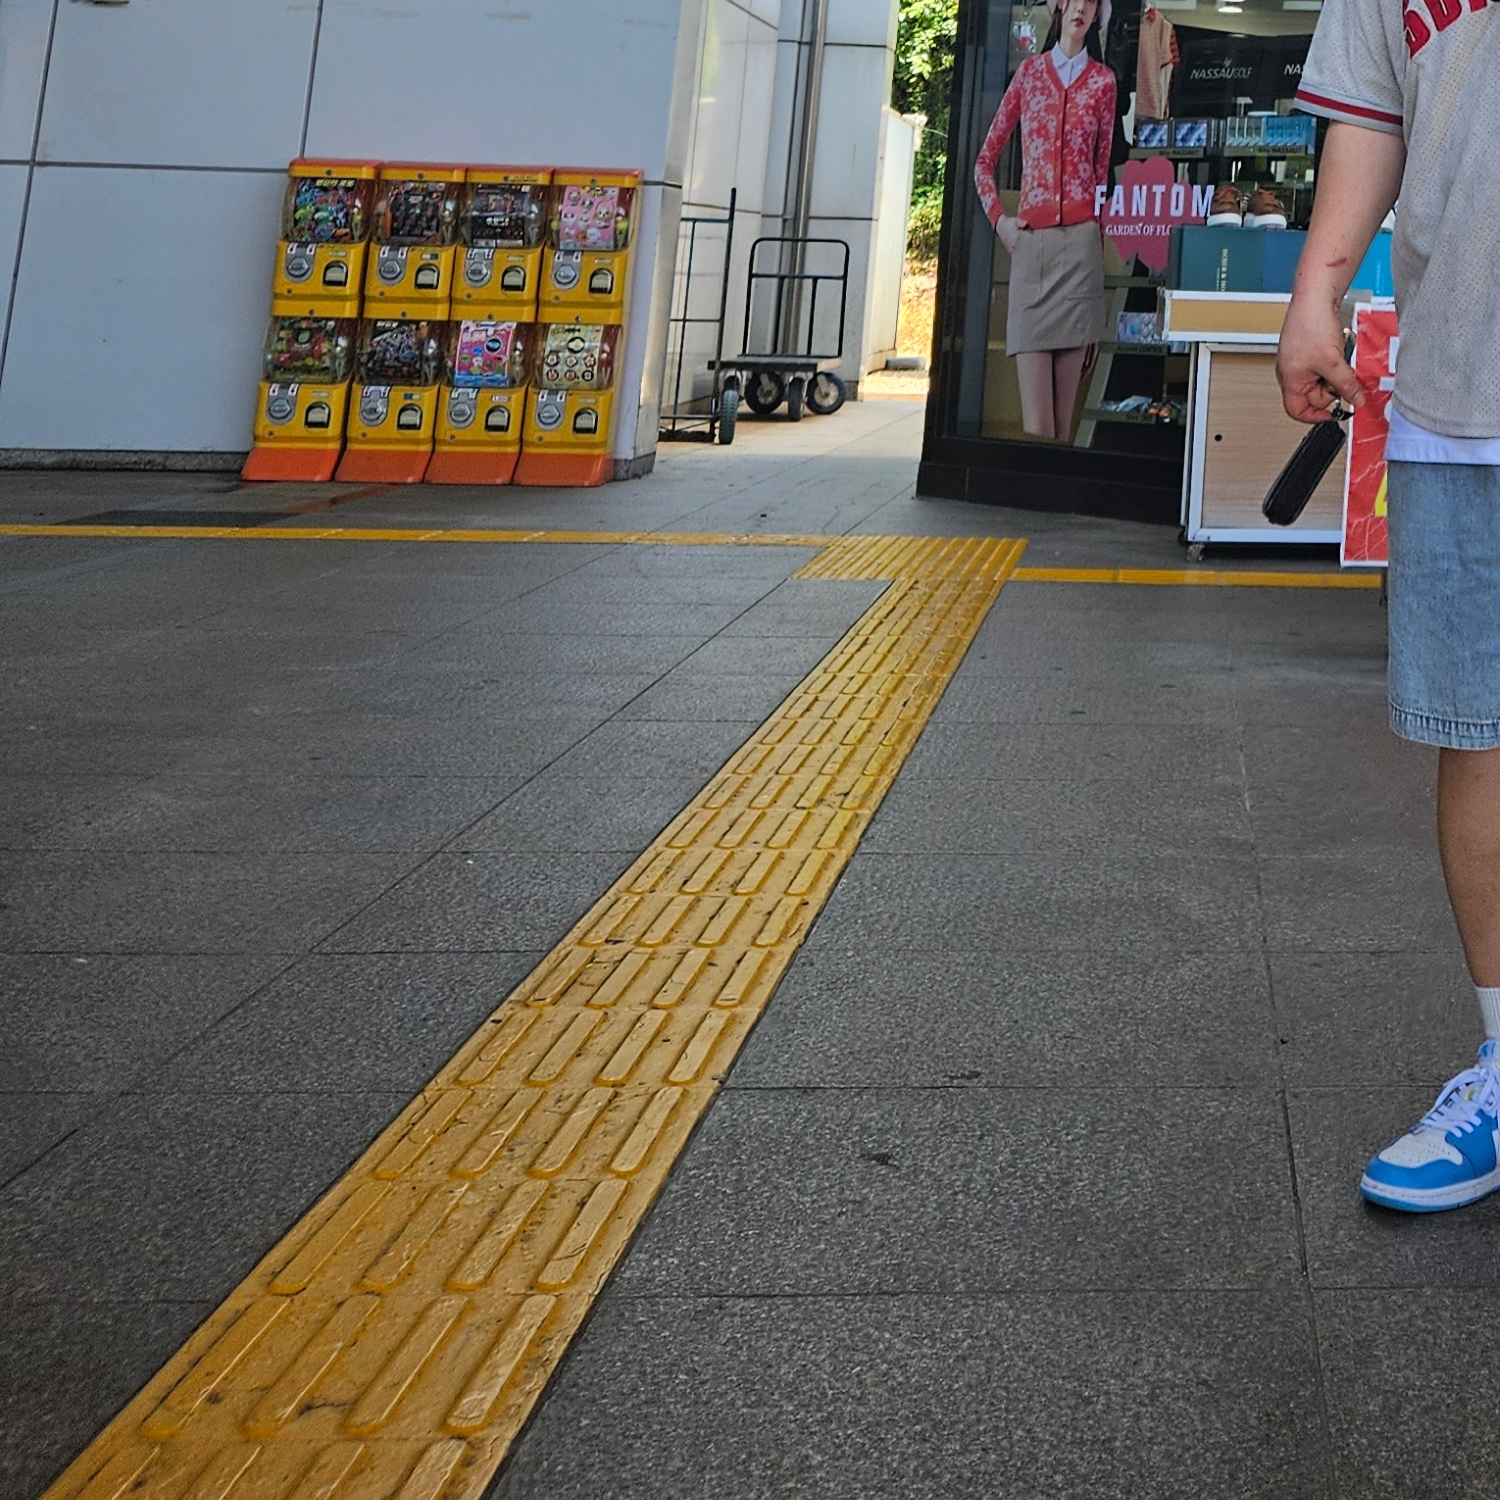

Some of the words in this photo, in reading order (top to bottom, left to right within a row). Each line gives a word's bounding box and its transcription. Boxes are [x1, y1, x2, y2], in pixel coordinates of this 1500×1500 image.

[1094, 184, 1216, 218] FANTOM
[1105, 224, 1142, 236] GARDEN
[1142, 225, 1156, 236] OF
